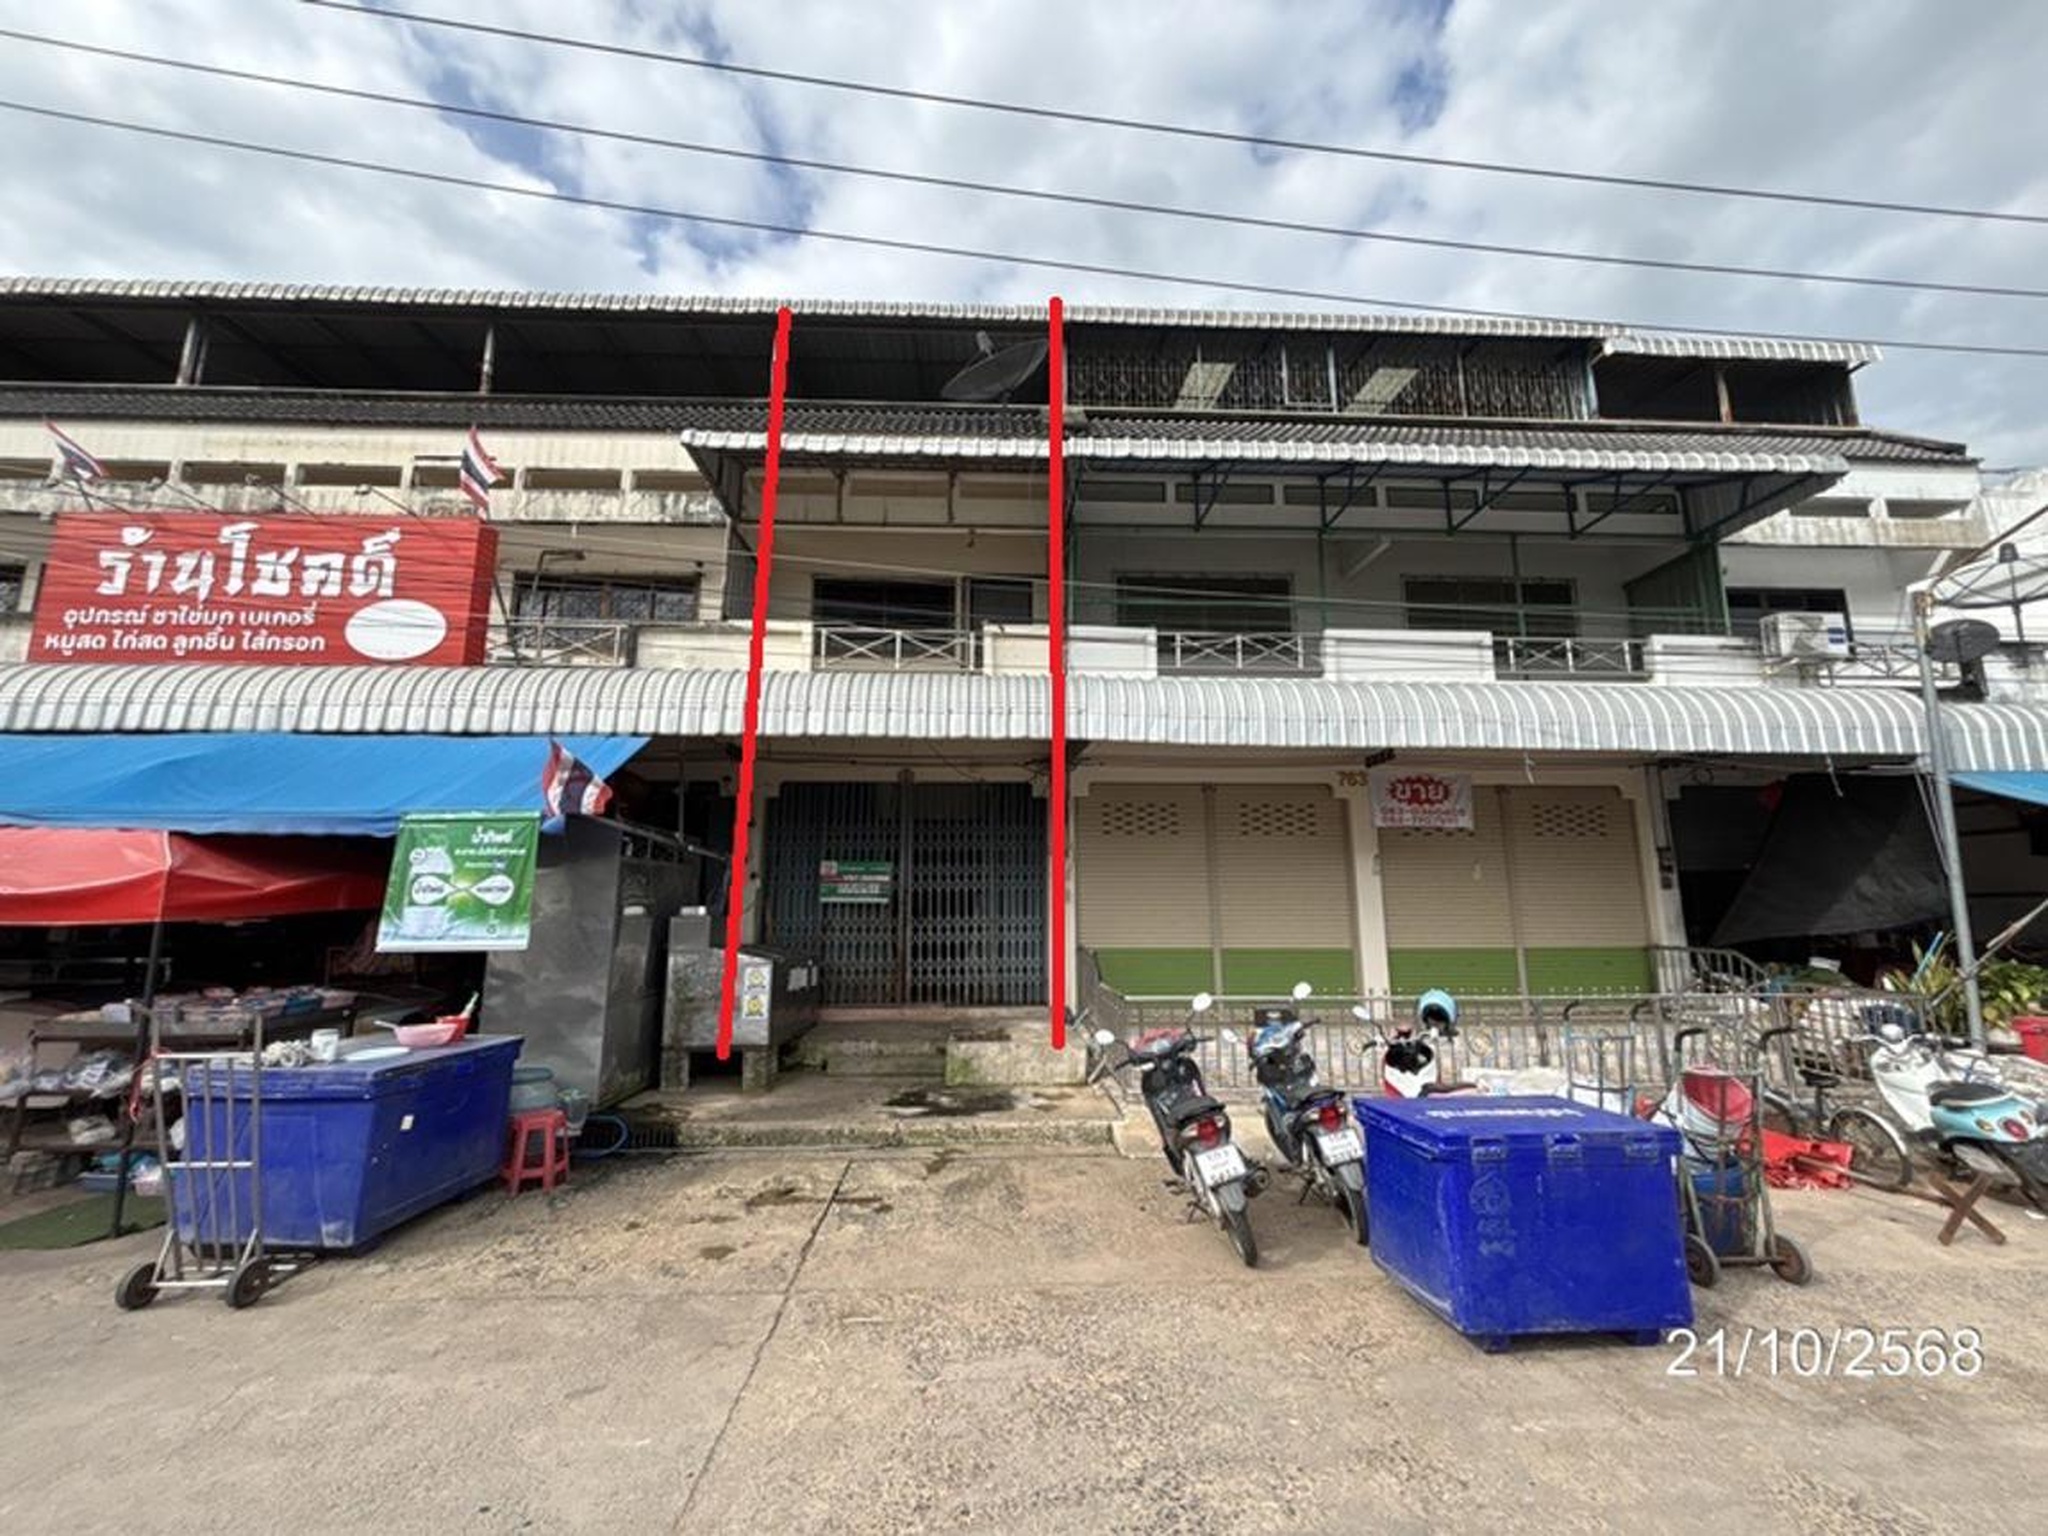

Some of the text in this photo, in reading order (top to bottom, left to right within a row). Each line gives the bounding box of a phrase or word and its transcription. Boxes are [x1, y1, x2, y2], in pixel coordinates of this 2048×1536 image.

[63, 604, 150, 630] อุปกรณ์
[240, 600, 317, 626] เบเกอรี่
[44, 625, 326, 656] หมูสด ไก่สด ลูกชิ้น ไส้กรอก
[1396, 782, 1445, 801] ขาย
